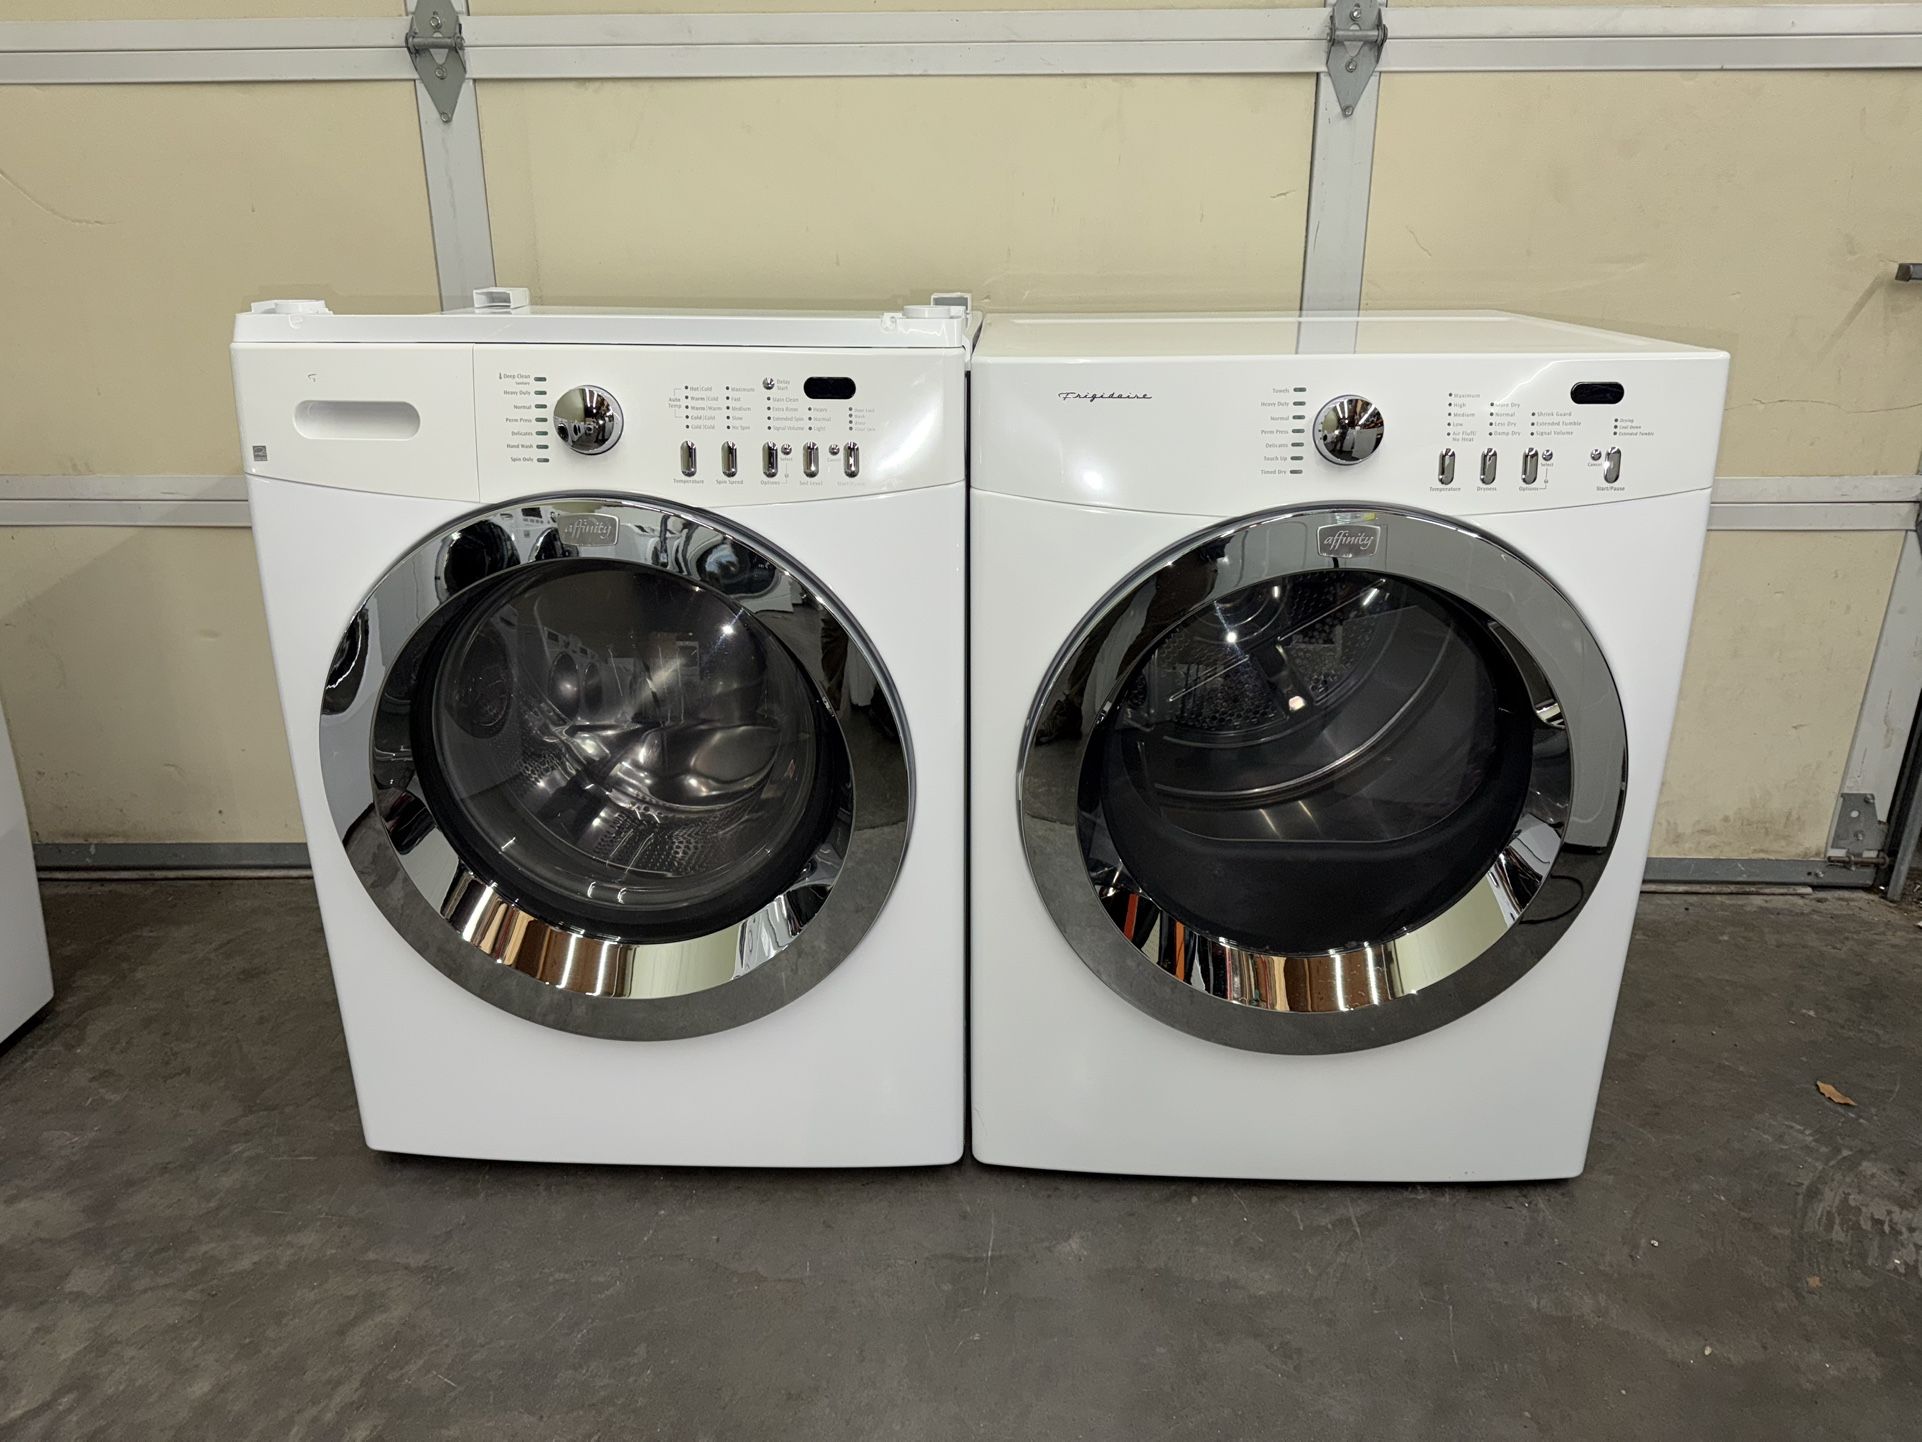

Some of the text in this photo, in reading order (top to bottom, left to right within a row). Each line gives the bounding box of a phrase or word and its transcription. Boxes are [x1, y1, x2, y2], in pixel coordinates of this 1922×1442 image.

[1058, 392, 1153, 403] Frigidaire
[564, 519, 612, 540] affinity
[1324, 530, 1374, 550] affinity
